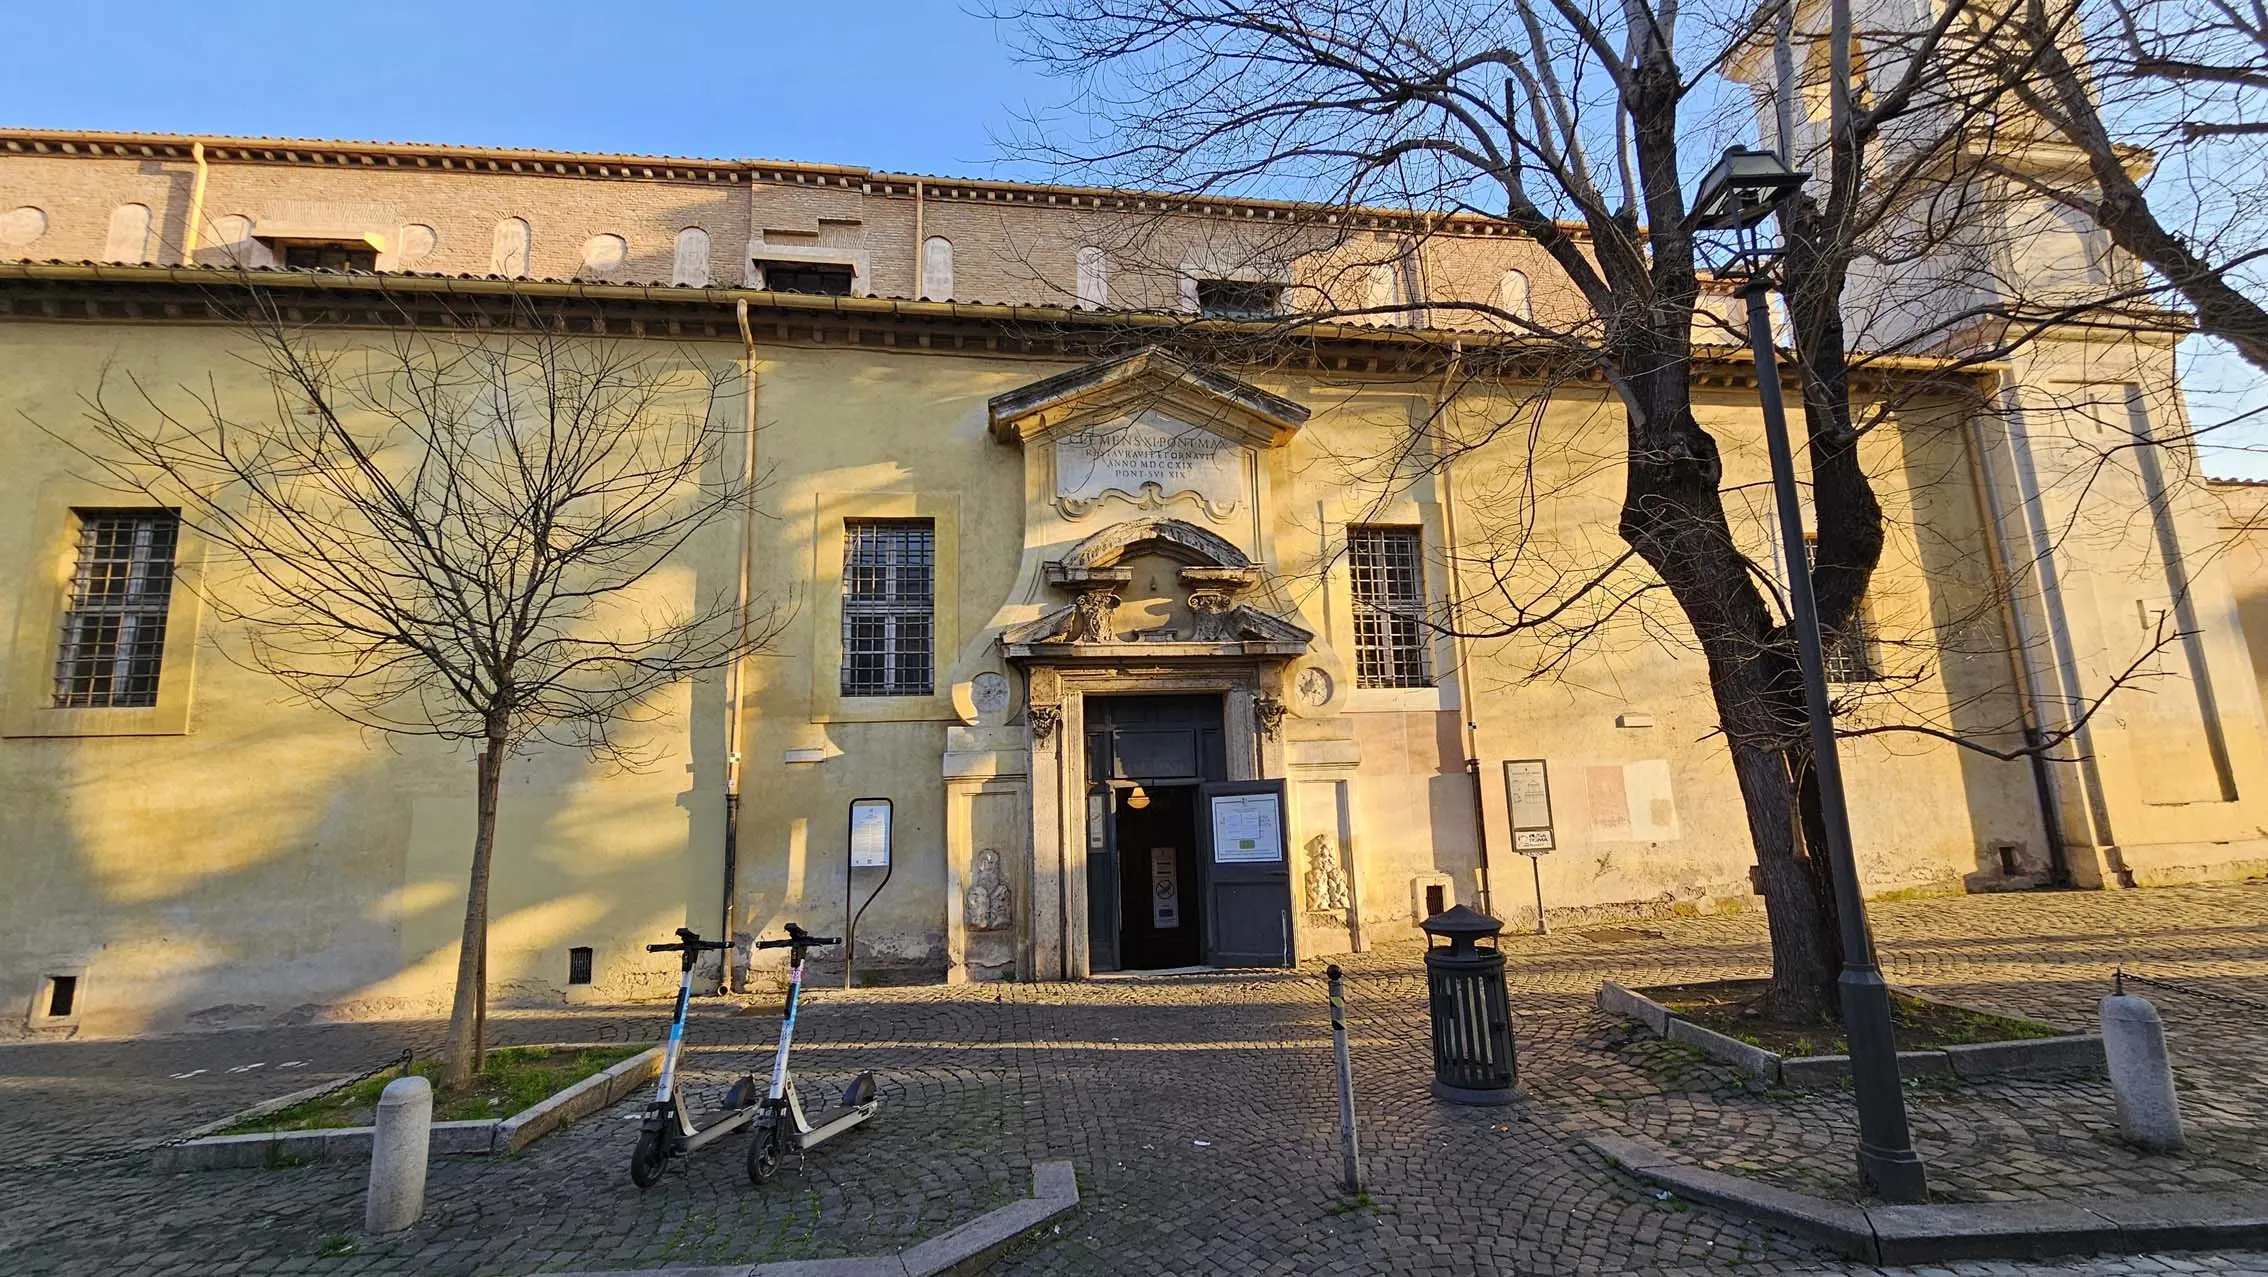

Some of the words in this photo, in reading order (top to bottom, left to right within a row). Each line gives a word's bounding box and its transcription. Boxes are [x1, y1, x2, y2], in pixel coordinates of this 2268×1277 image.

[1069, 434, 1141, 446] LEMENS
[1107, 459, 1137, 469] ANNO
[1141, 461, 1193, 470] MDCCXIX
[1168, 471, 1186, 479] XIX
